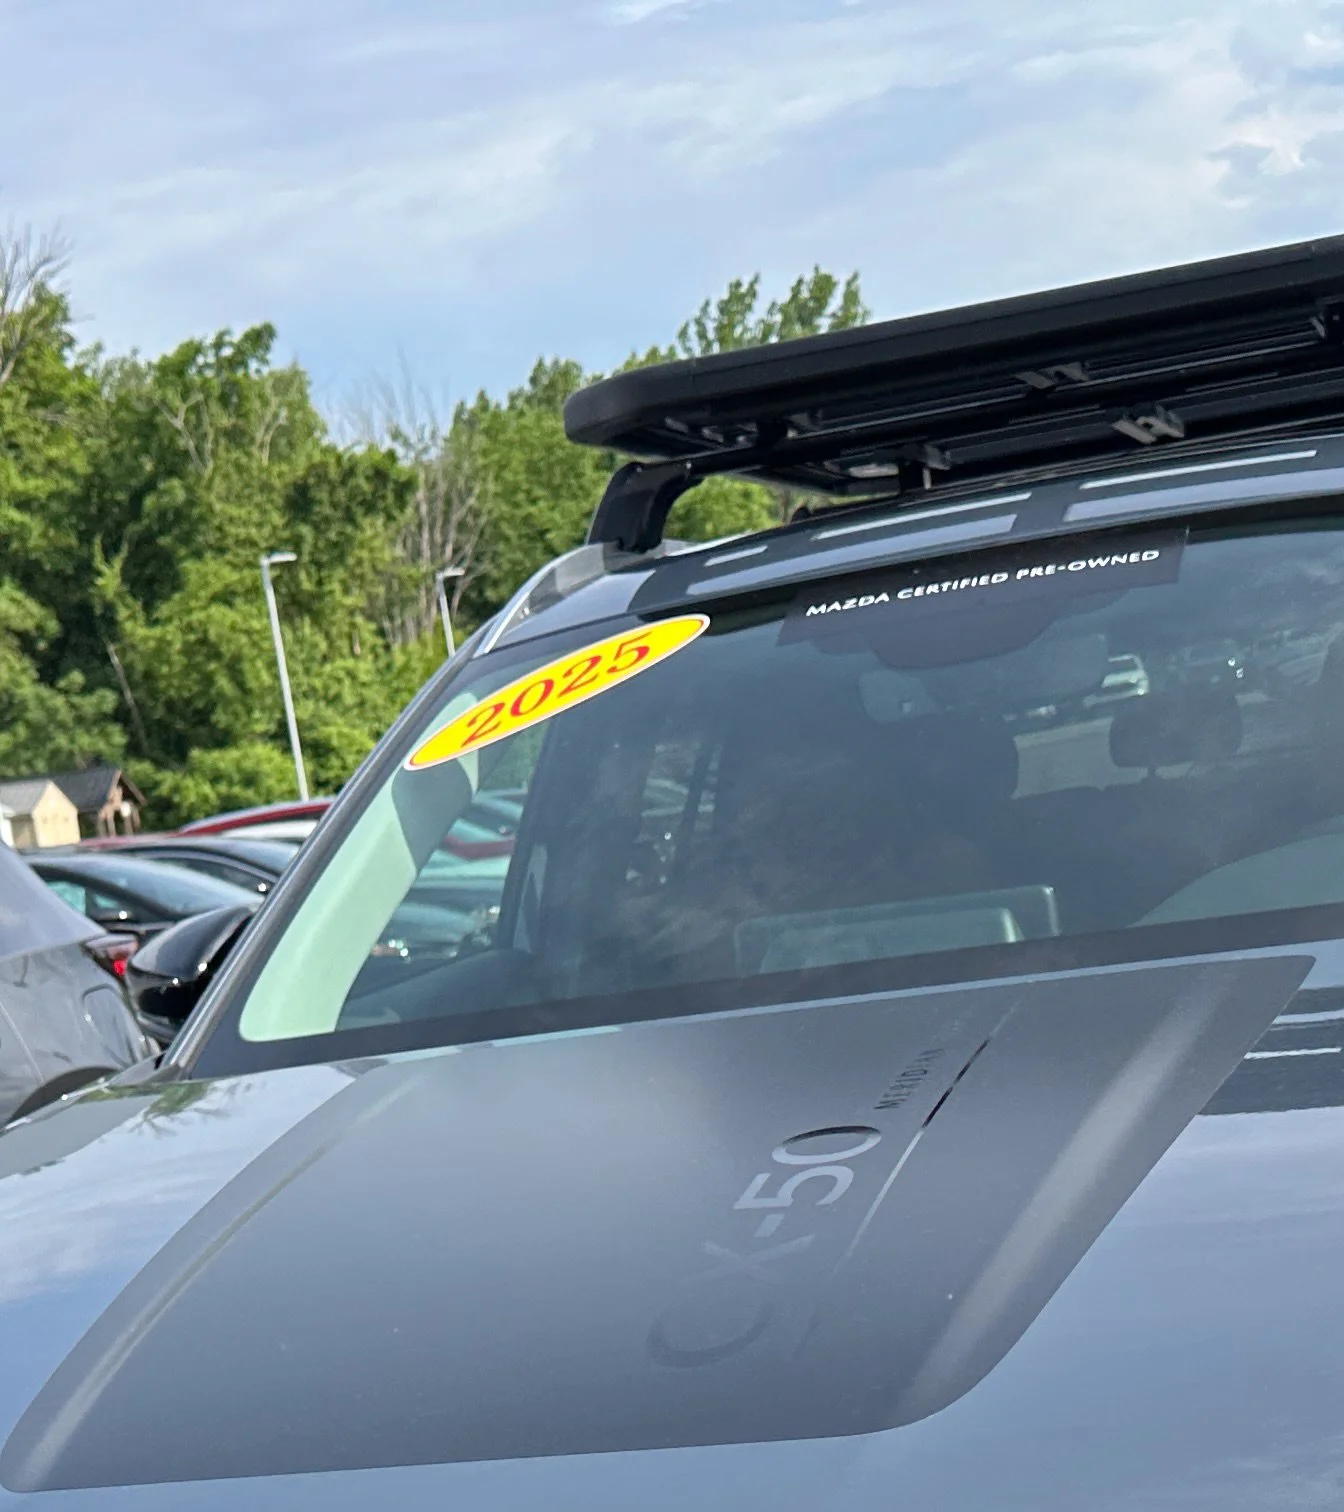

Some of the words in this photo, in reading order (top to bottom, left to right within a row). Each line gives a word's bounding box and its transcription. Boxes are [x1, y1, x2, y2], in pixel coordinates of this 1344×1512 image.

[805, 593, 889, 616] MAZDA
[897, 572, 1008, 600] CERTIFIED
[1016, 550, 1160, 581] PRE-OWNED
[461, 631, 654, 748] 2025
